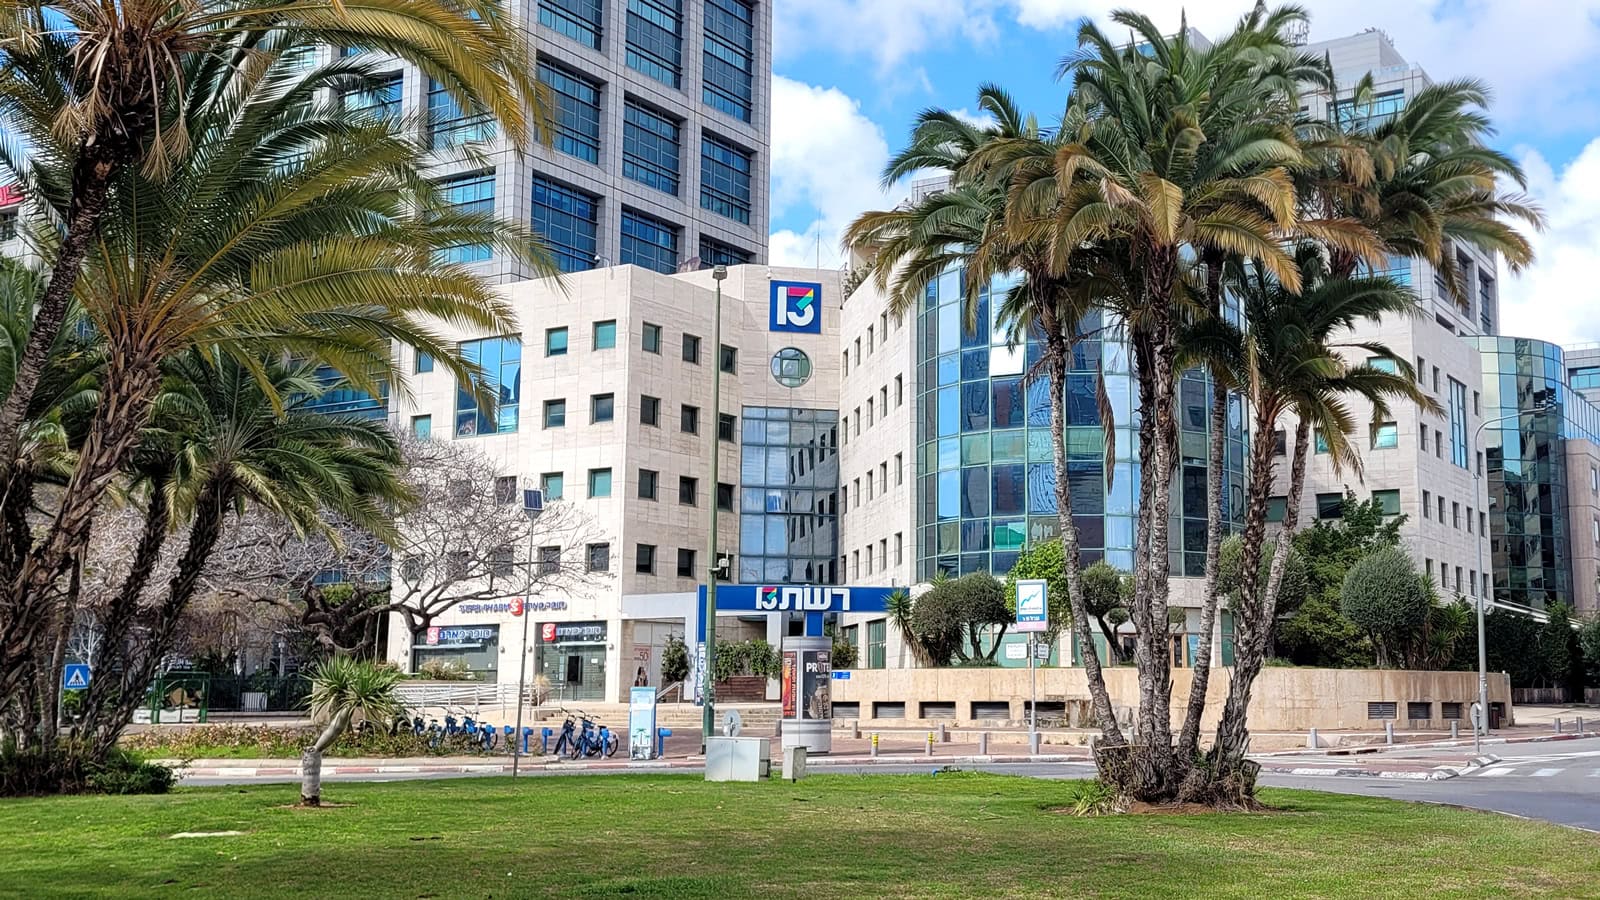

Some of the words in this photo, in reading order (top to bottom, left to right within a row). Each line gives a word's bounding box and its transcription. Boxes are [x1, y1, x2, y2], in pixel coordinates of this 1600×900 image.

[777, 286, 814, 327] 13
[756, 586, 778, 610] 13
[779, 587, 850, 611] רשת
